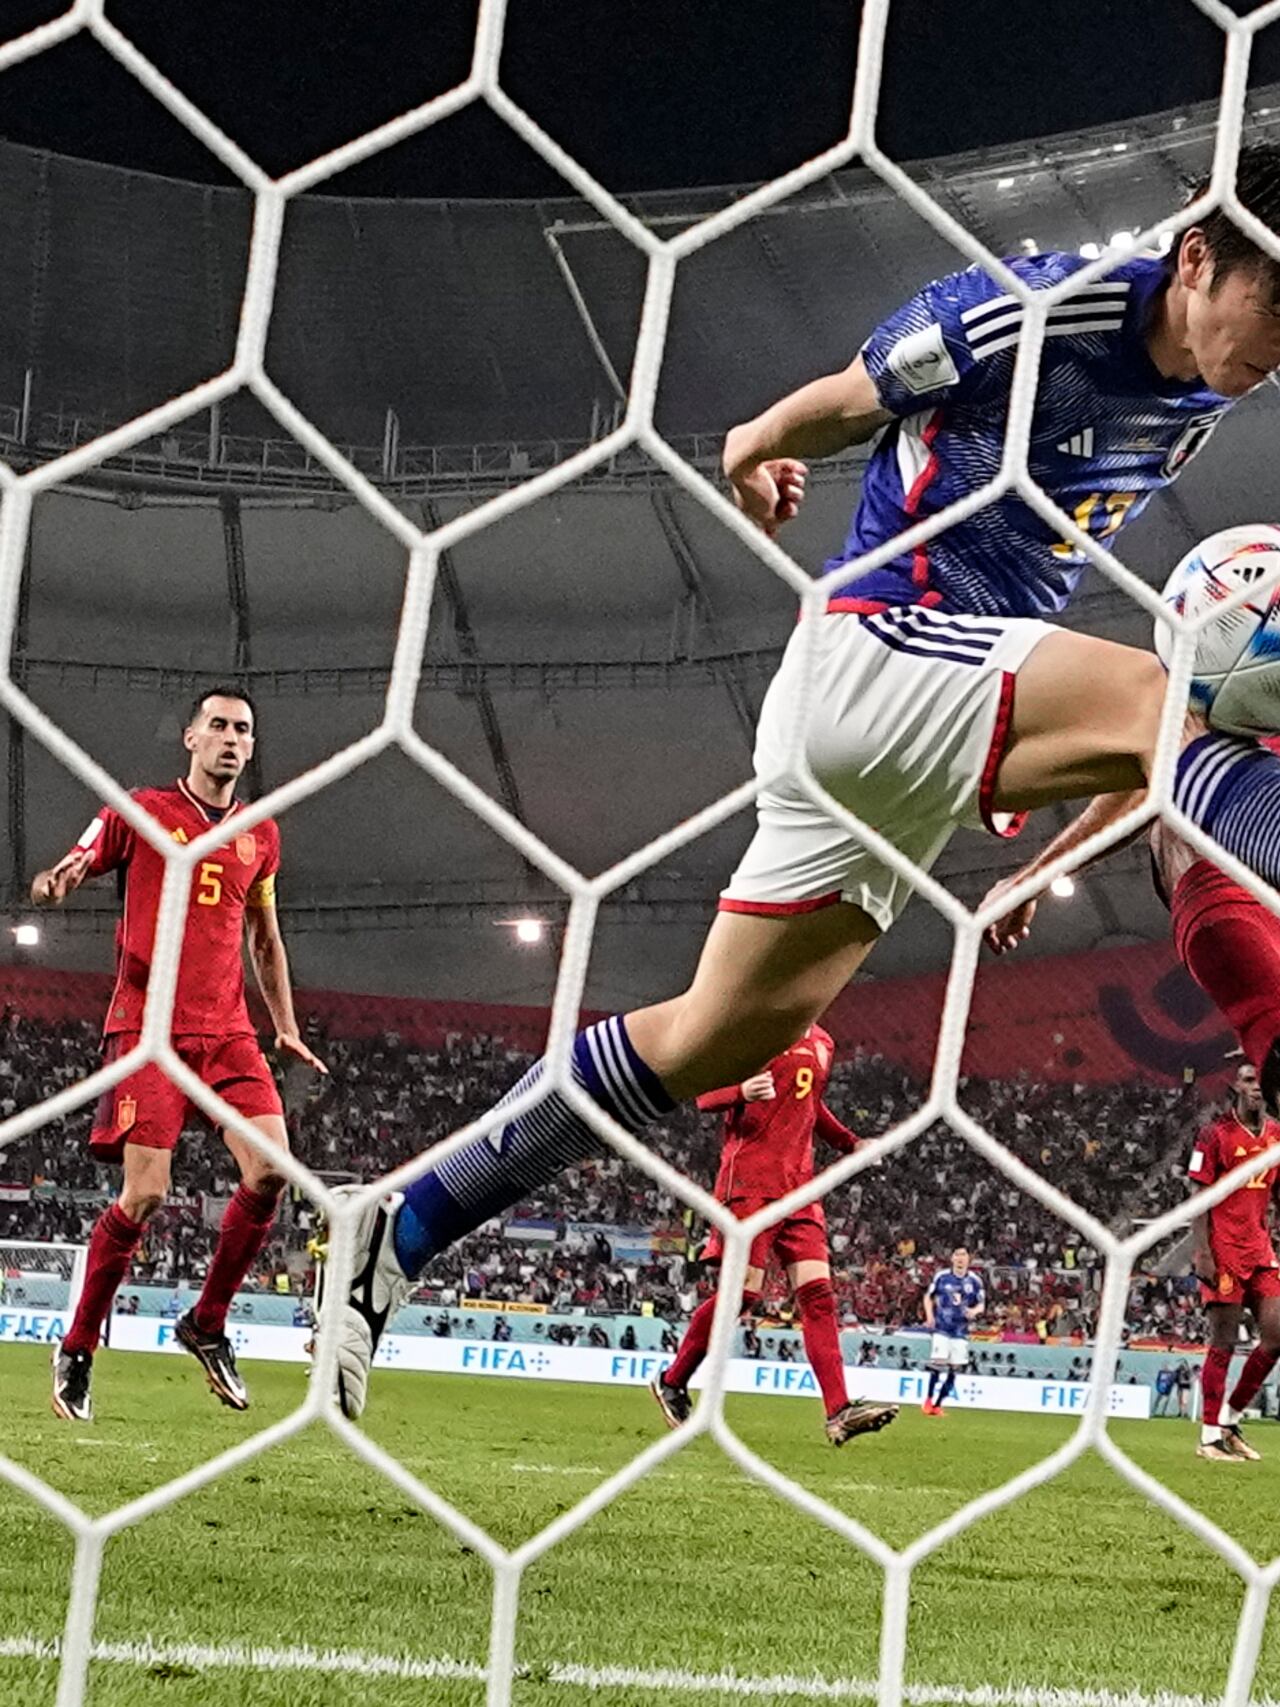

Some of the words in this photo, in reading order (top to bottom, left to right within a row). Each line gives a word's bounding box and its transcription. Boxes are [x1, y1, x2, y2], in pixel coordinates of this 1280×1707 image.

[197, 862, 223, 906] 5
[795, 1067, 814, 1100] 9
[462, 1346, 527, 1372] FIFA
[755, 1366, 816, 1391] FIFA
[1041, 1385, 1092, 1409] FIF
